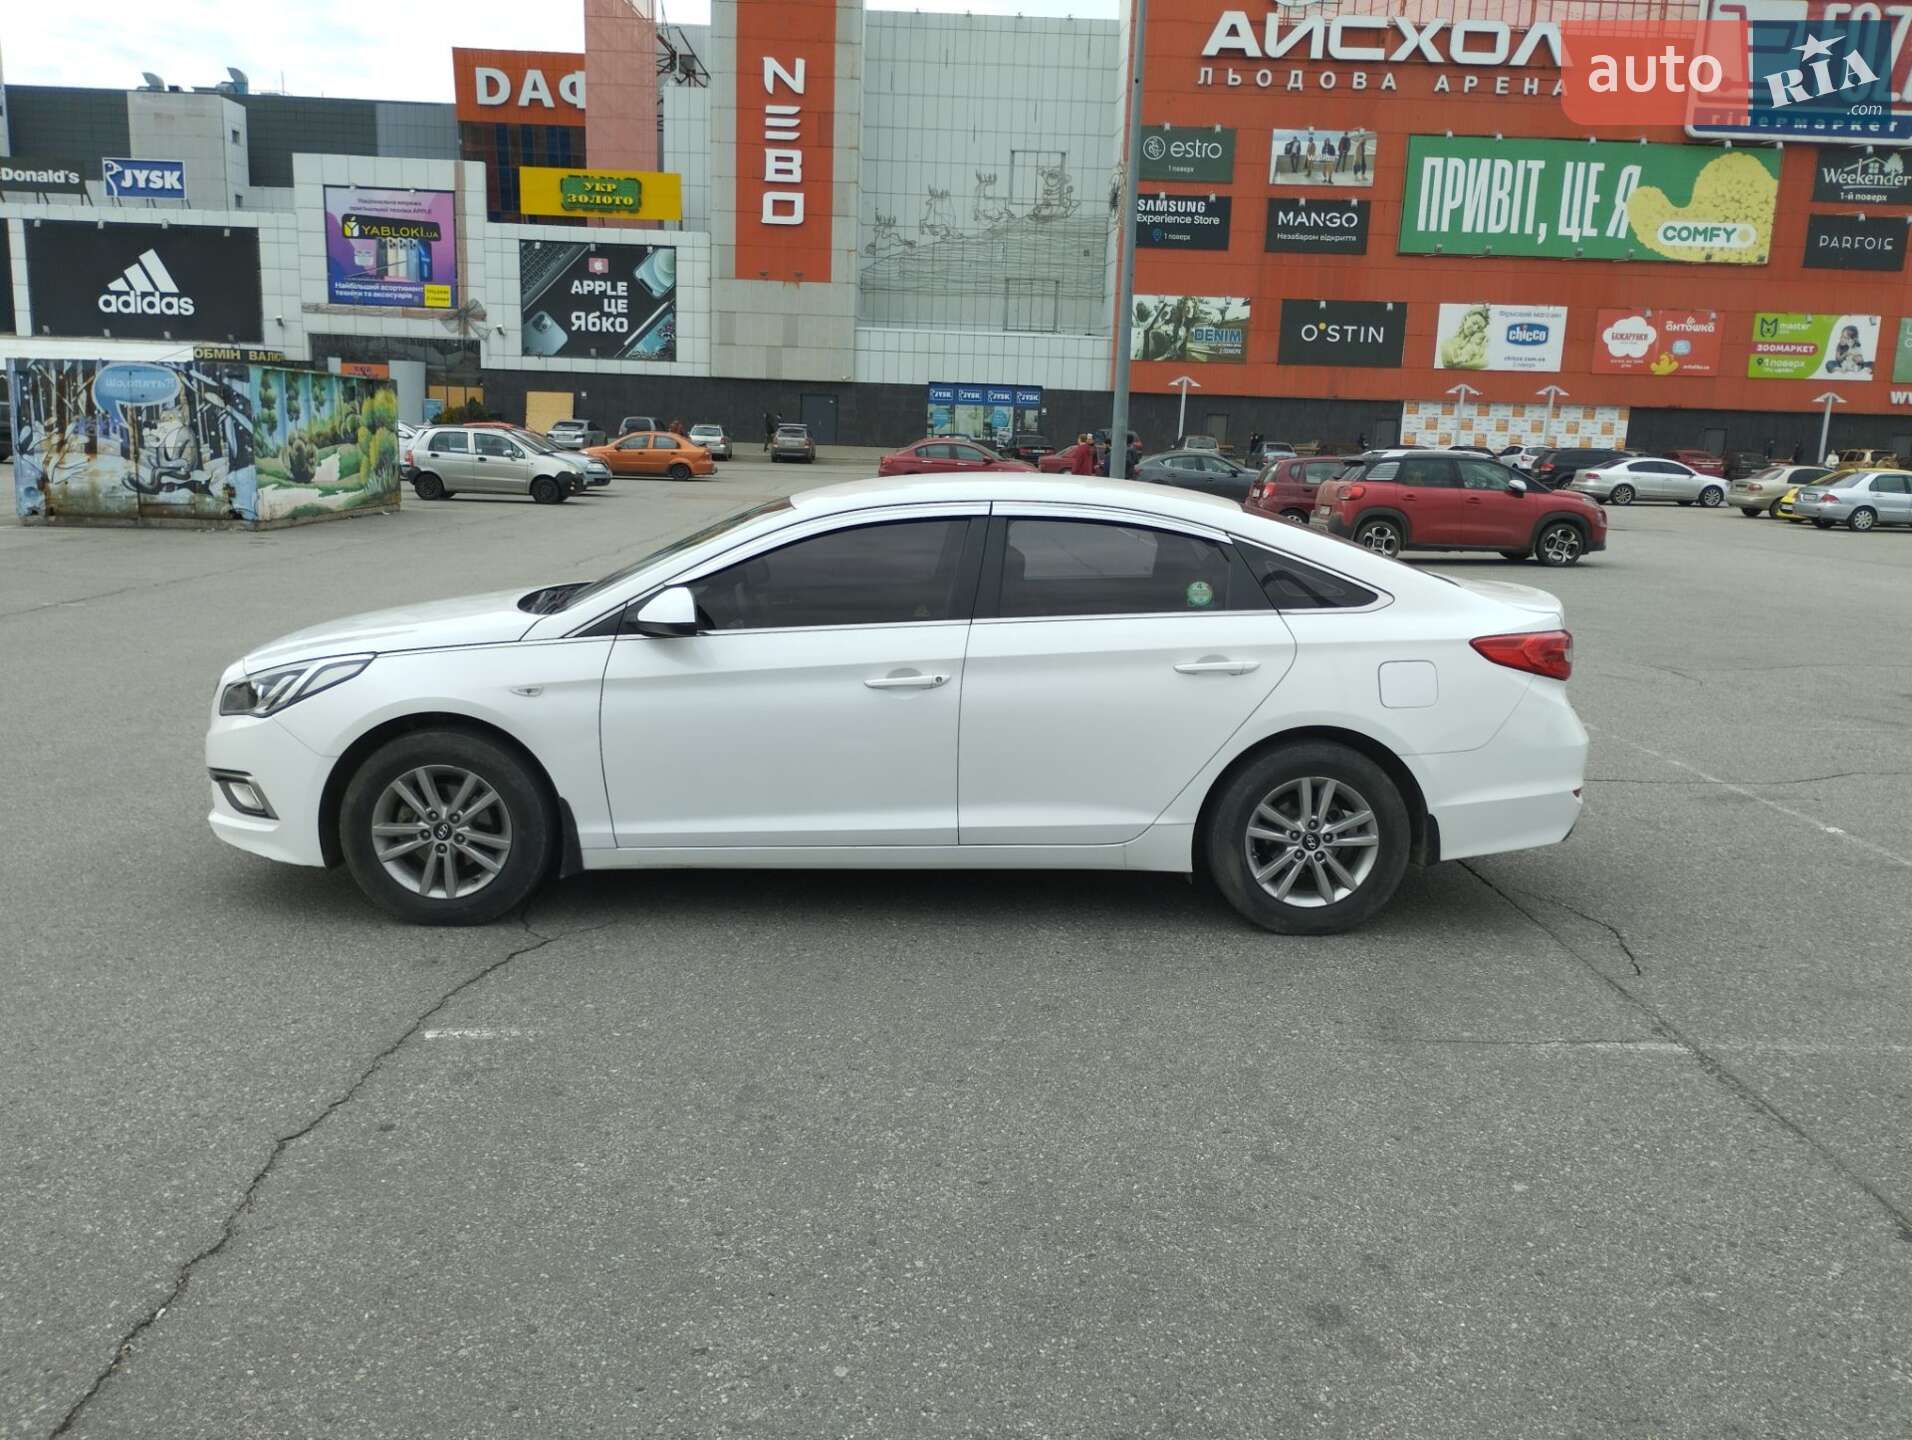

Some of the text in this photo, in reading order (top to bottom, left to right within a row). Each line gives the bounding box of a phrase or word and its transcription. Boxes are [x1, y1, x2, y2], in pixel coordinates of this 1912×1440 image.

[1198, 67, 1568, 96] ЛЬОДОВА АРЕНА
[1170, 139, 1223, 159] estro
[0, 167, 80, 184] Donald's
[121, 168, 183, 190] JYSK
[1822, 165, 1912, 186] Weekender
[583, 182, 617, 193] УКР
[568, 193, 634, 206] ЗОЛОТО
[1137, 200, 1206, 213] SAMSUNG
[1417, 157, 1643, 244] ПРИВІТ, ЦЕ Я
[1137, 214, 1220, 225] Experience Store
[1277, 211, 1358, 227] MANGO
[1662, 226, 1738, 242] COMFY
[571, 280, 629, 296] APPLE
[98, 290, 195, 316] adidas
[604, 299, 629, 315] ЦЕ
[571, 311, 629, 333] Ябко
[1194, 328, 1241, 343] DENIM
[1509, 326, 1547, 342] chicco
[194, 347, 241, 360] ОБМІН
[1757, 344, 1815, 353] ЗООМАРКЕТ
